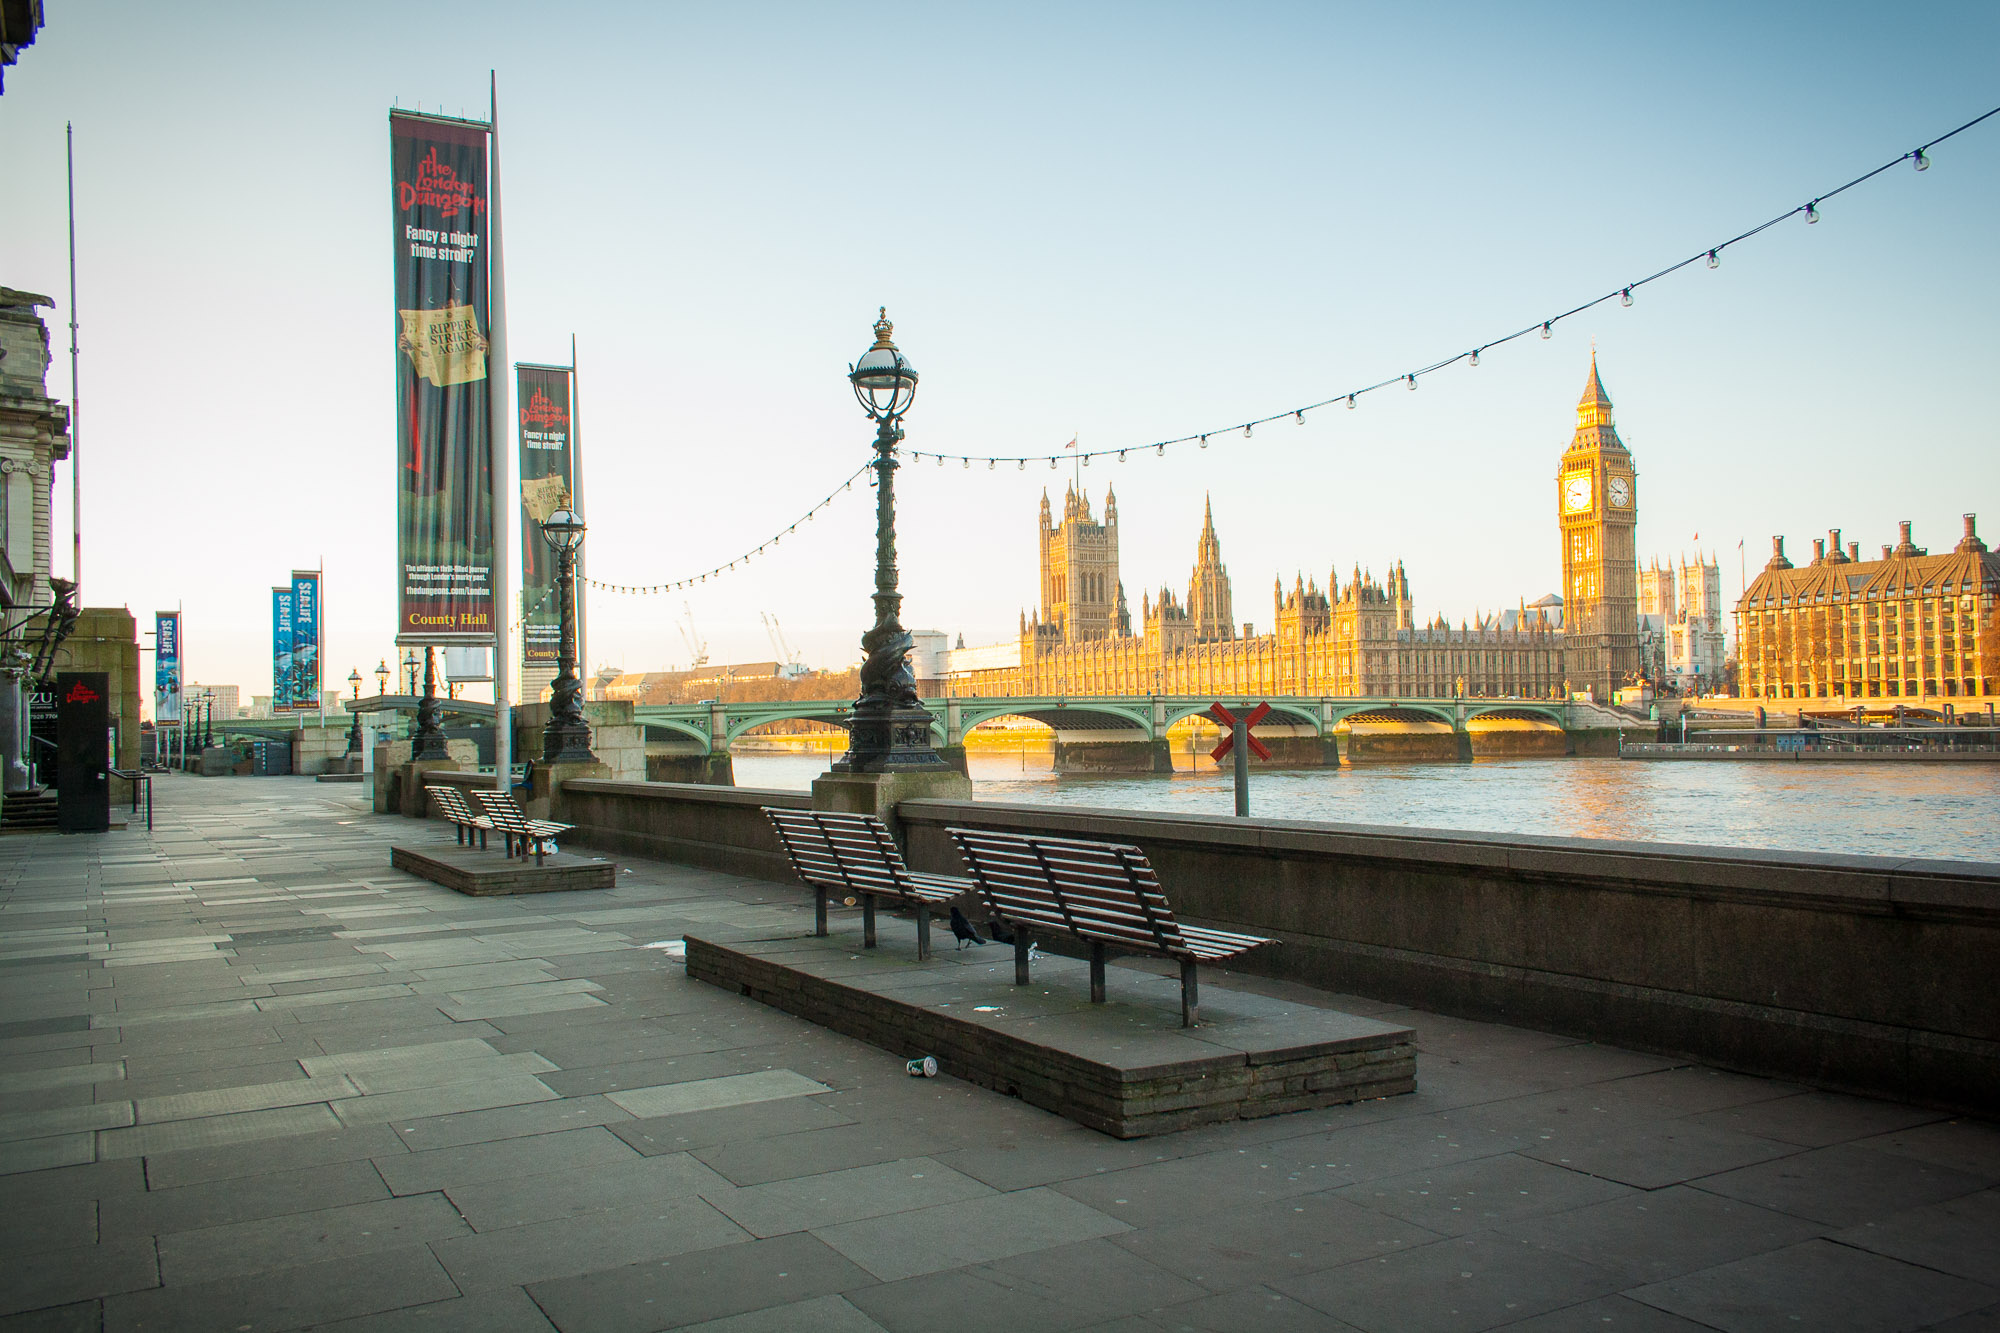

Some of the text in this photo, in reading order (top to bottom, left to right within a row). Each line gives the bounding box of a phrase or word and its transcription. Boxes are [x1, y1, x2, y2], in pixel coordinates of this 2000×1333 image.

[421, 146, 451, 177] the
[415, 163, 474, 196] London
[399, 181, 485, 218] Dungeon
[406, 225, 479, 248] Fancy a night
[411, 243, 474, 263] time stroll?
[430, 320, 473, 334] RIPPER
[430, 329, 479, 345] STRIKES
[439, 340, 473, 355] AGAIN
[520, 407, 569, 428] Dungeon
[524, 430, 566, 441] Fancy a night
[526, 439, 564, 450] time stroll?
[405, 564, 416, 572] The
[468, 566, 490, 574] journey
[408, 573, 431, 581] through
[298, 582, 313, 603] SEA
[278, 595, 291, 613] SEA
[409, 613, 488, 627] County Hall
[161, 620, 174, 637] SEA
[528, 649, 556, 659] County
